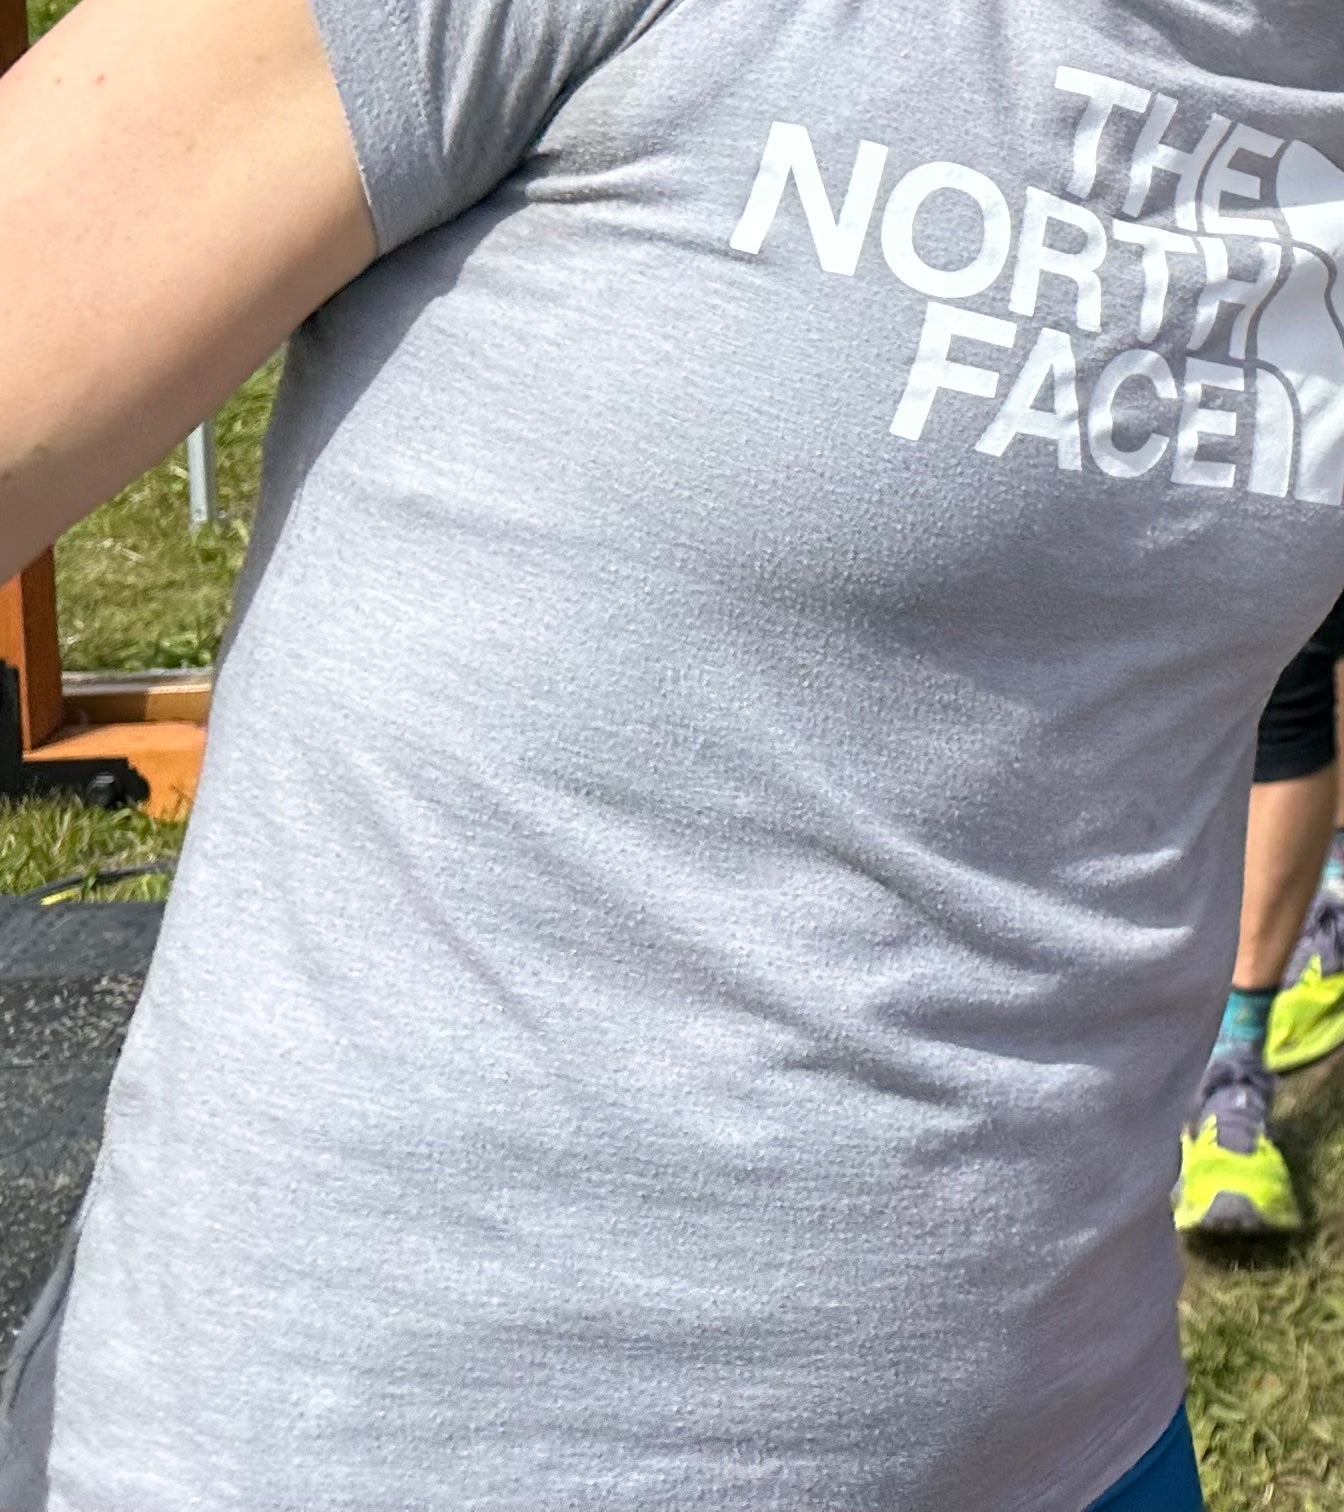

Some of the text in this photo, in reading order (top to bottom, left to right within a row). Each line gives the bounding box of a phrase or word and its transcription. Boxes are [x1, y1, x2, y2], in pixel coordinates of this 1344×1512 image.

[729, 120, 1290, 361] NORTH
[1055, 65, 1288, 239] THE
[889, 302, 1247, 488] FACE
